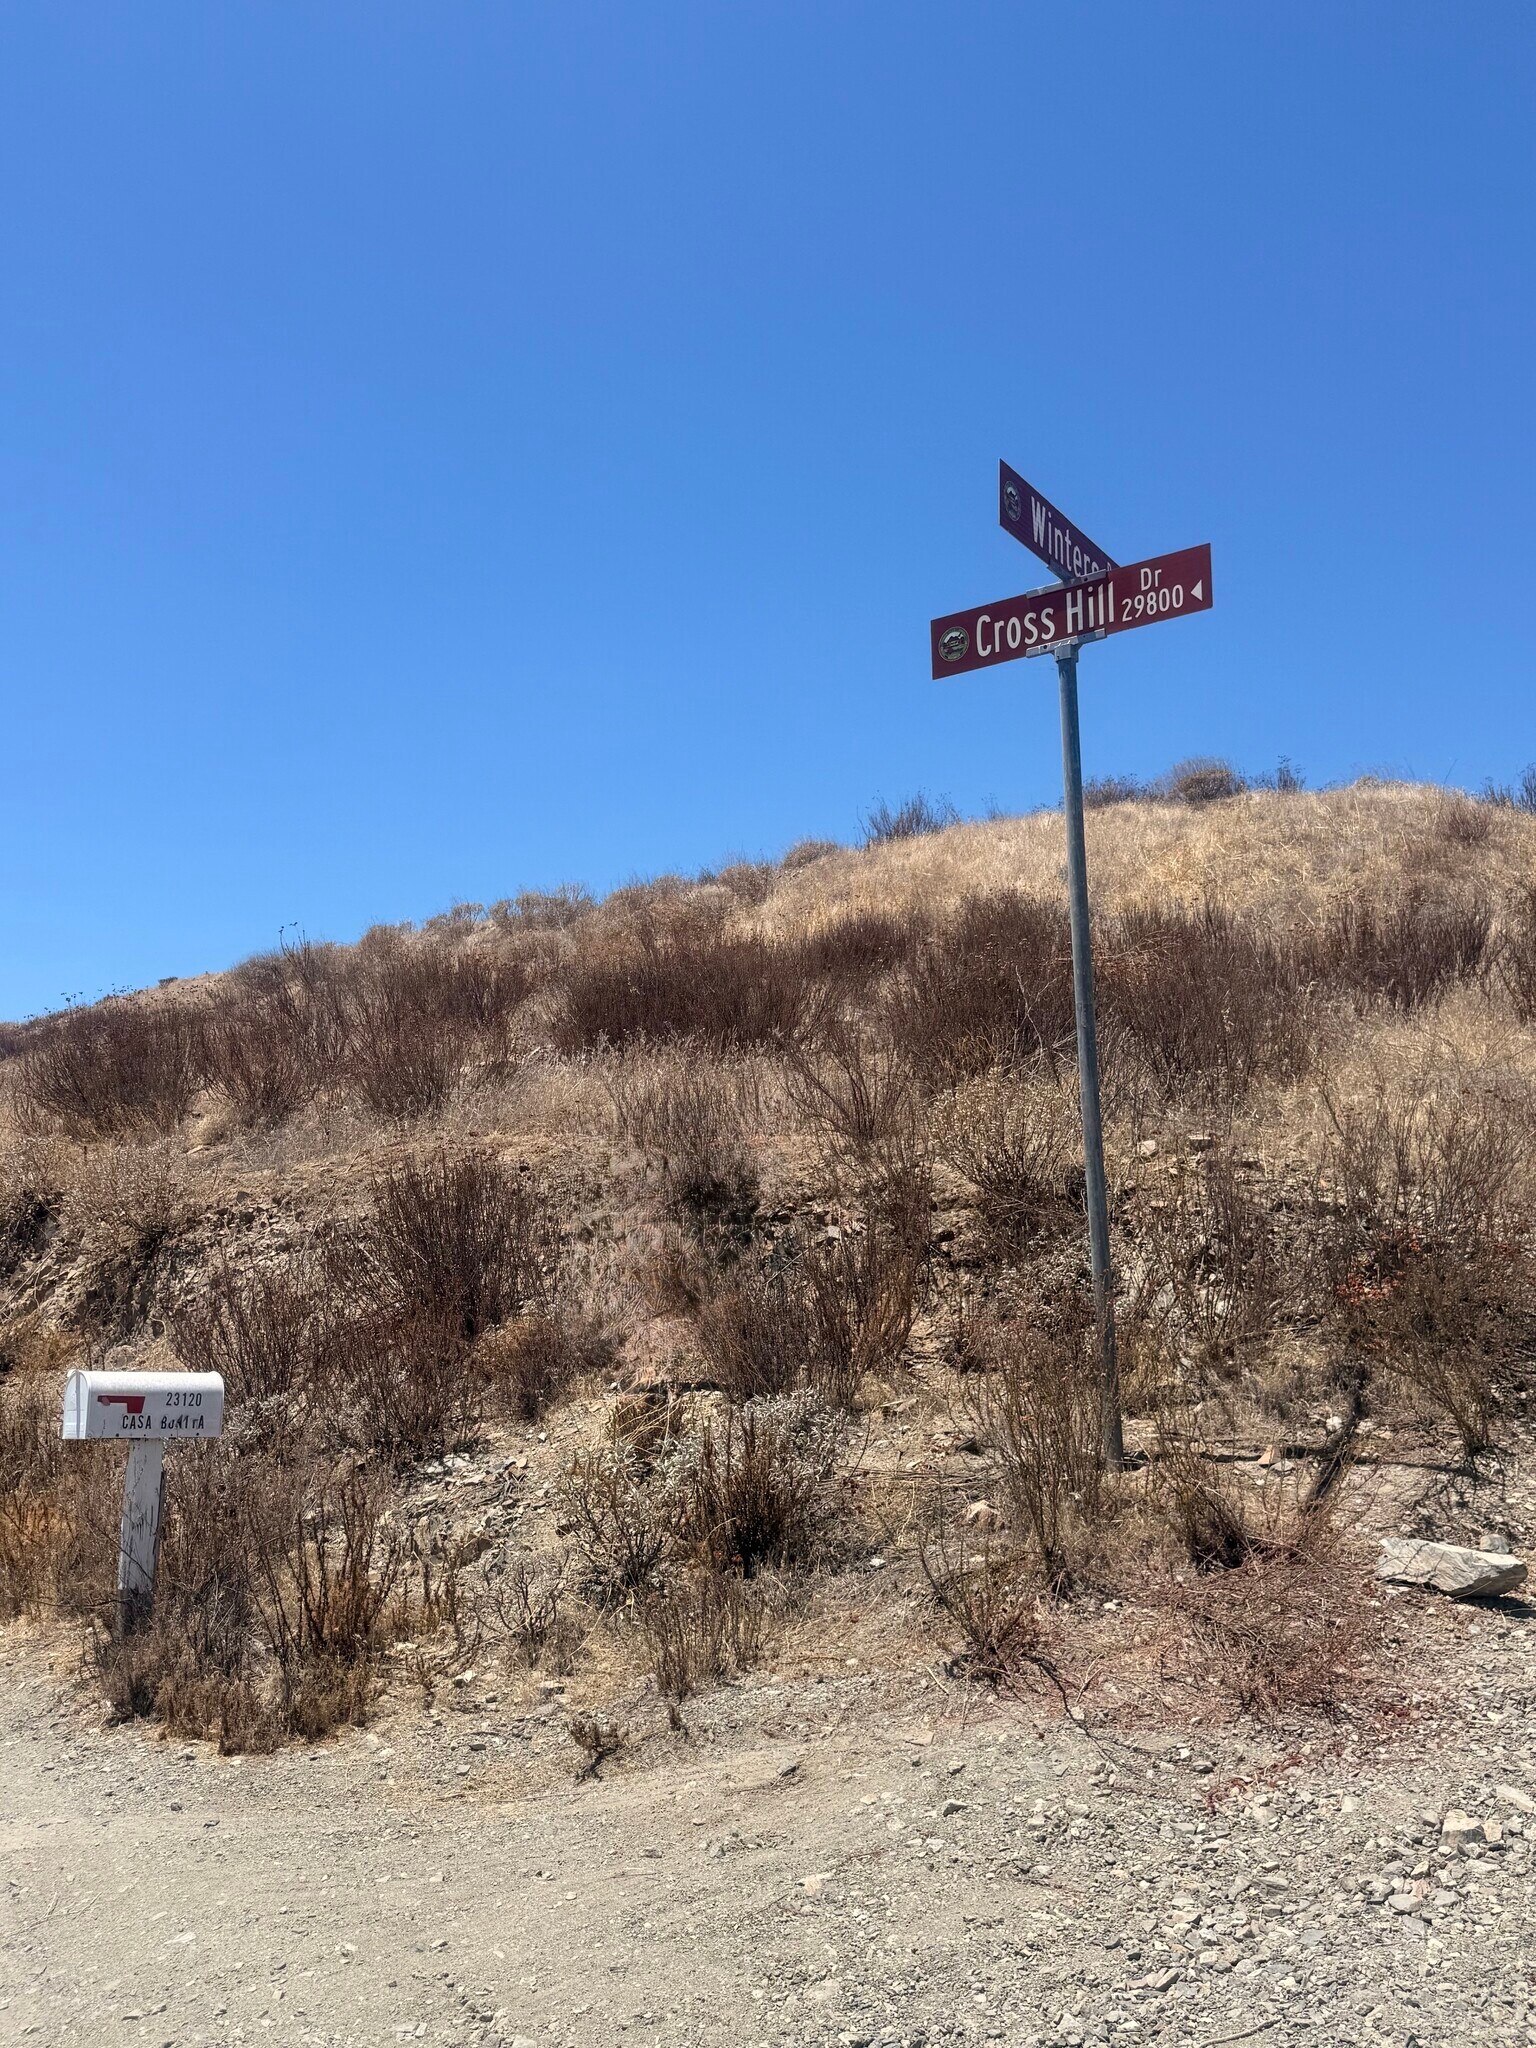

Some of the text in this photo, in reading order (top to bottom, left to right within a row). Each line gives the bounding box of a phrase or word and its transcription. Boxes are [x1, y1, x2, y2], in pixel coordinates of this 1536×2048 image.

[976, 567, 1162, 657] Cross Hill Dr
[1121, 584, 1184, 622] 29800
[166, 1392, 202, 1406] 23120
[122, 1415, 152, 1429] CASA
